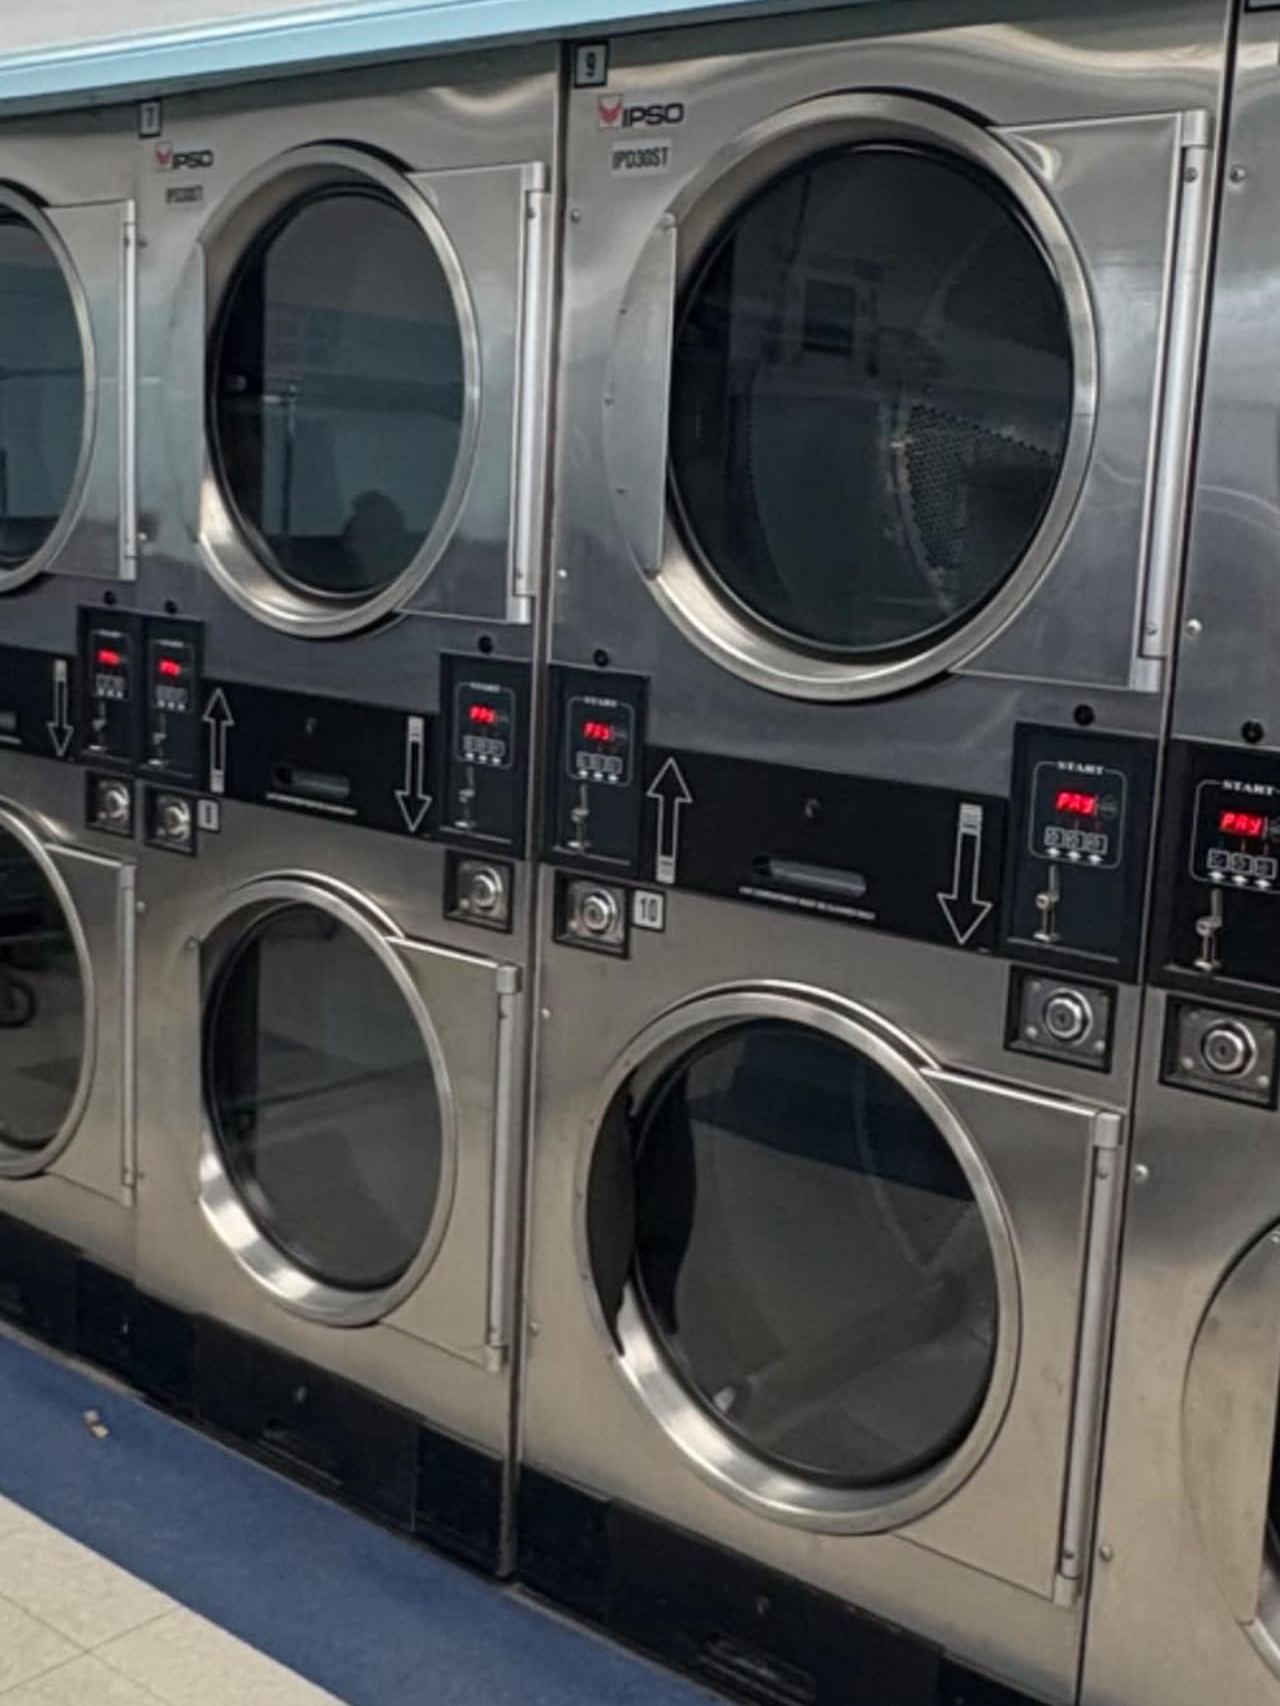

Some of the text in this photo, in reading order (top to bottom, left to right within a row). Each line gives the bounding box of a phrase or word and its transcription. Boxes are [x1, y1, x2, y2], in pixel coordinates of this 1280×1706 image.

[586, 51, 597, 78] 9
[622, 103, 684, 128] IPSO
[1223, 780, 1275, 796] START
